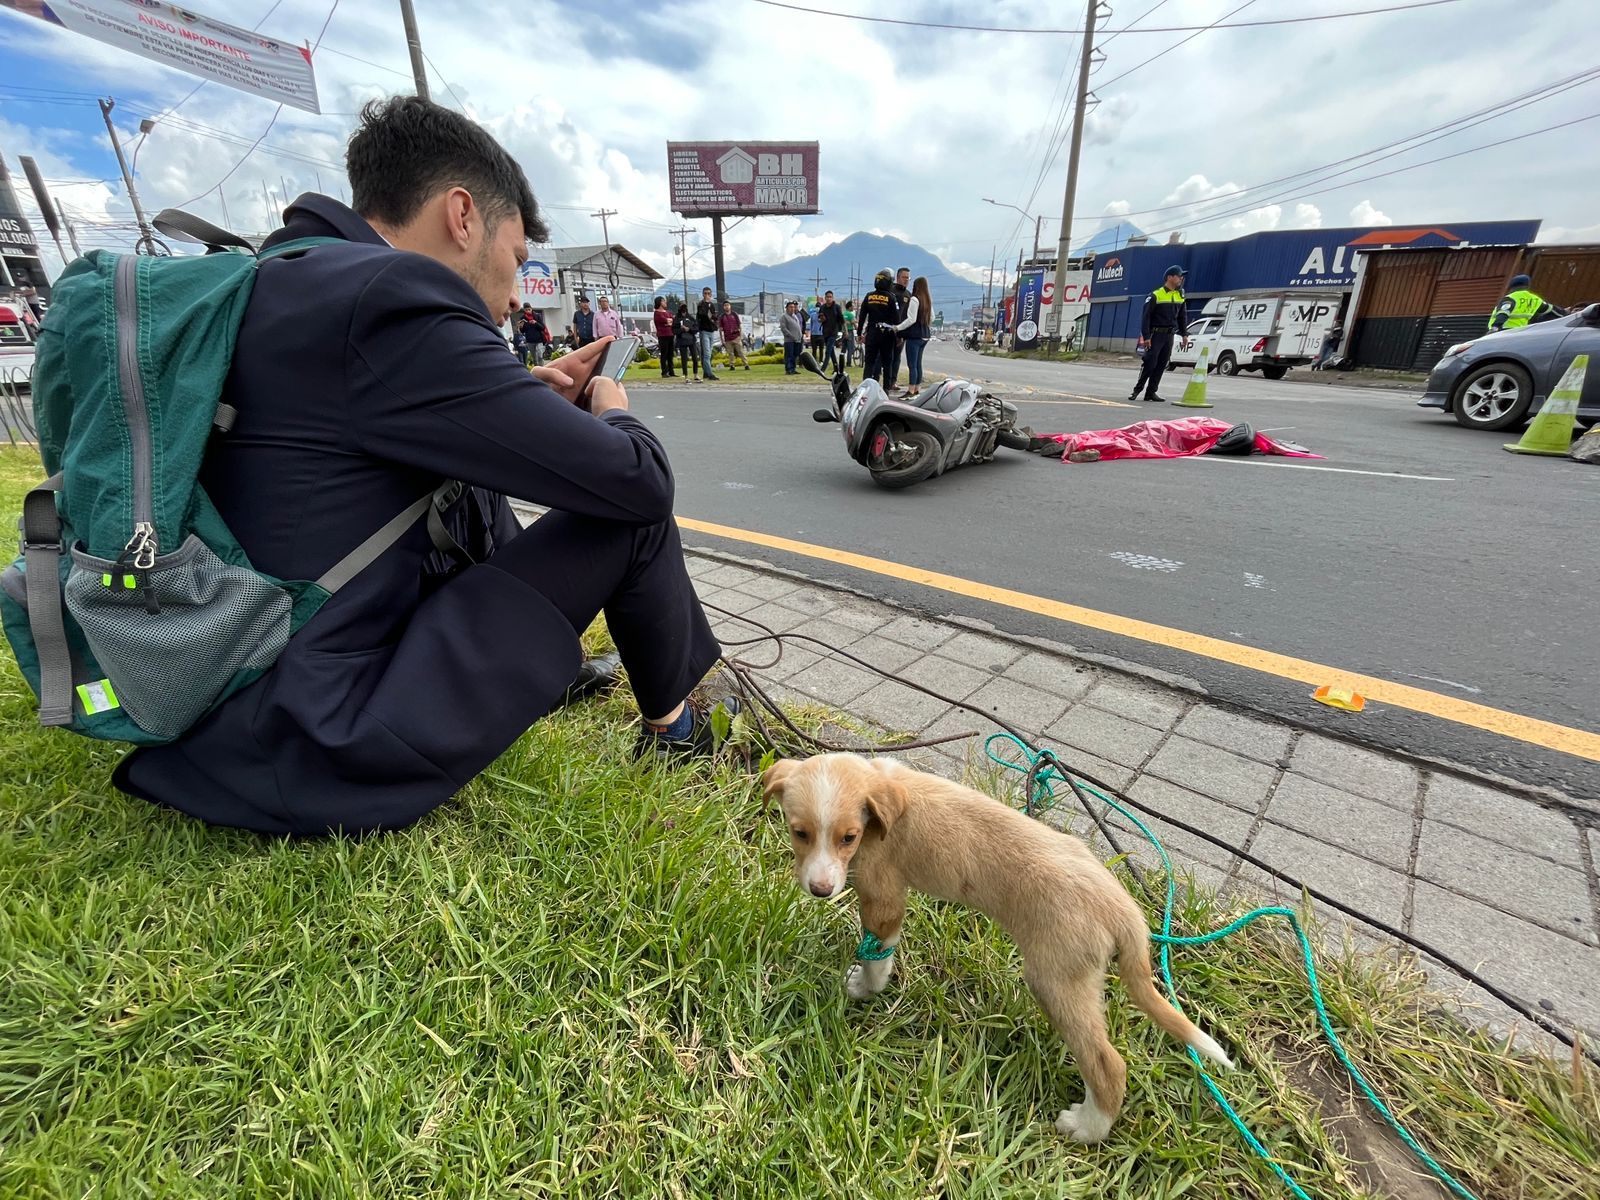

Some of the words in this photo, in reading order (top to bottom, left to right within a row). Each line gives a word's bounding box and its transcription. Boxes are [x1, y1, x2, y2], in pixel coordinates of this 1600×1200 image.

[97, 18, 144, 40] SEPTIEMBRE
[145, 36, 162, 47] ESTA
[163, 42, 174, 51] VIA
[175, 46, 222, 68] PERMANECERA
[138, 12, 176, 34] AVISO
[179, 27, 252, 62] IMPORTANTE
[193, 46, 241, 69] INDEPENDENCIA
[152, 46, 196, 65] RECOMIENDA
[196, 59, 217, 74] TOMAR
[218, 69, 232, 80] VIAS
[233, 75, 262, 90] ALTERNAS
[758, 153, 803, 175] BH
[792, 177, 806, 185] POR
[756, 187, 807, 204] MAYOR
[1097, 265, 1124, 280] Alutech
[522, 277, 554, 295] 1763
[1239, 303, 1268, 320] MP
[1295, 305, 1330, 322] MP
[1178, 341, 1194, 353] MP
[1239, 345, 1251, 354] 115
[1307, 338, 1321, 349] 115
